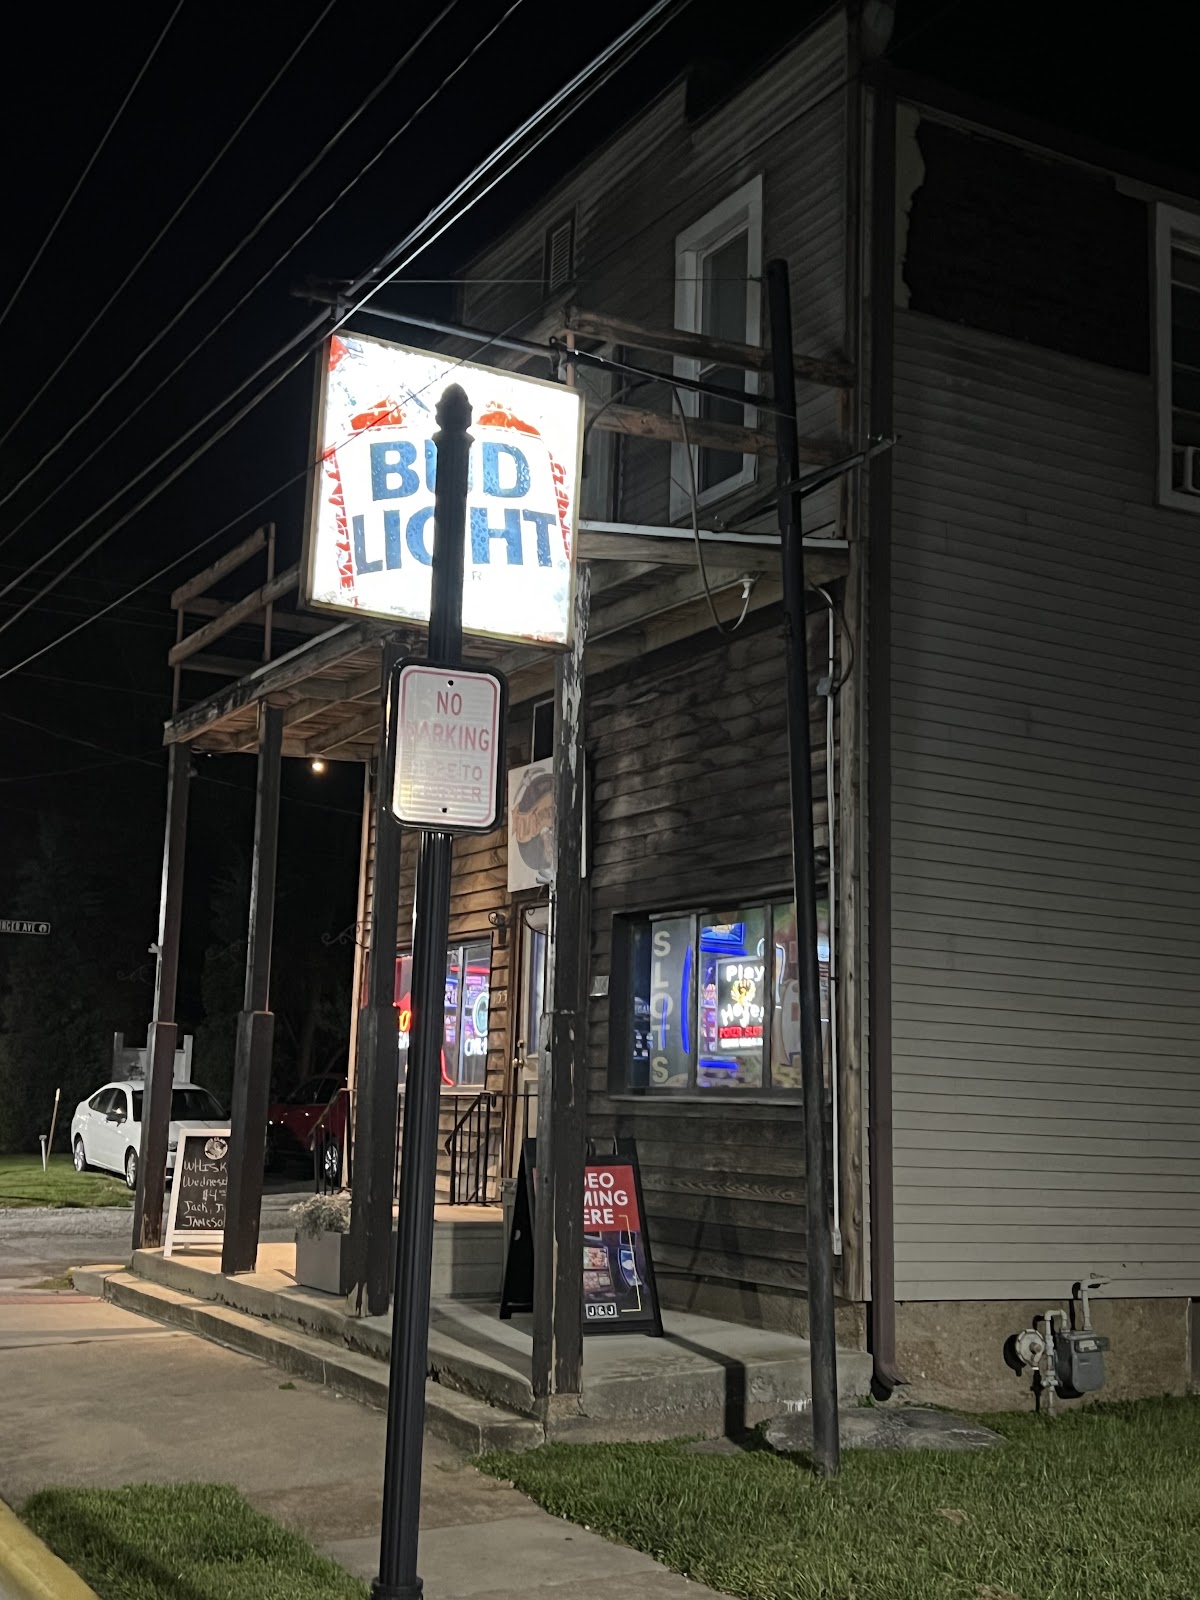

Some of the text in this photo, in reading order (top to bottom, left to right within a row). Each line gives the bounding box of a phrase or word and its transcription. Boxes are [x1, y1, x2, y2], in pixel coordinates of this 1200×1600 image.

[436, 690, 462, 716] NO
[461, 764, 482, 781] TO
[726, 964, 765, 983] Play
[651, 930, 674, 1084] SLOTS
[584, 1172, 614, 1188] EO
